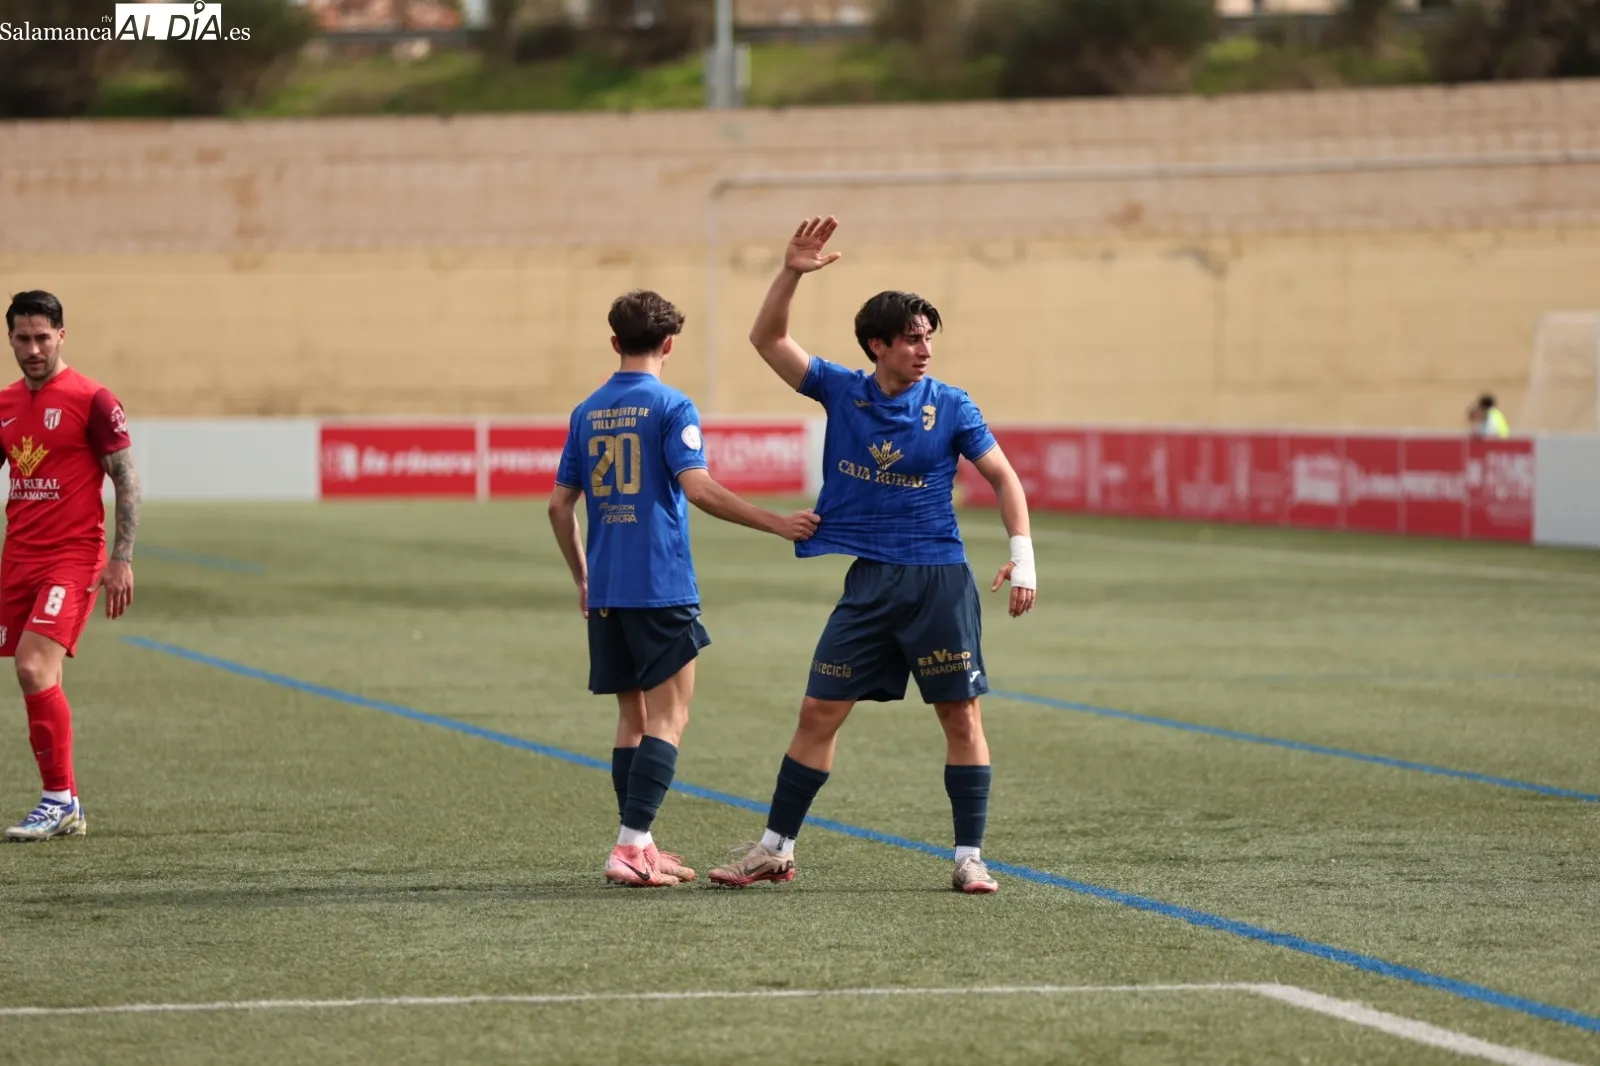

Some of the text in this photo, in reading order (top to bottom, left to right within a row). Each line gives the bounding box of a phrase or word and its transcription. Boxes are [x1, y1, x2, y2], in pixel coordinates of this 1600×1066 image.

[638, 407, 650, 417] DE
[592, 417, 637, 430] VILLAALBO
[588, 432, 641, 497] 20
[838, 459, 928, 488] CAJA RURAL
[23, 478, 60, 490] RURAL
[44, 585, 67, 617] 8
